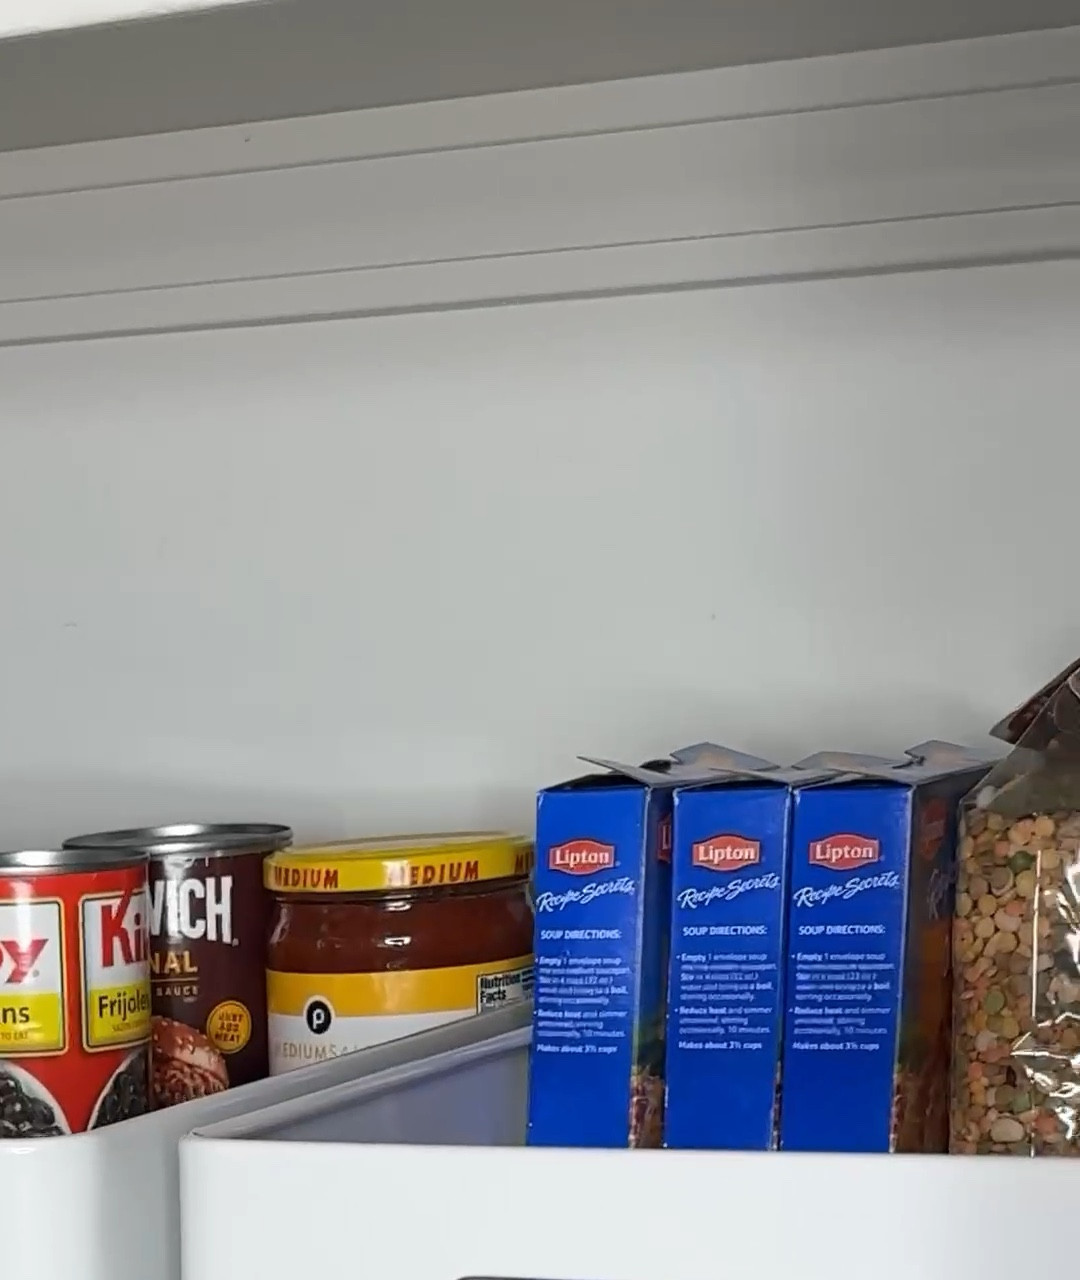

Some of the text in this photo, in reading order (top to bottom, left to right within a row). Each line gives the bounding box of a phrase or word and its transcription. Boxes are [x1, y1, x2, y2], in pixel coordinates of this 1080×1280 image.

[554, 849, 610, 868] Lipton
[697, 845, 756, 864] Lipton
[815, 844, 873, 862] Lipton
[273, 868, 339, 889] MEDIUM
[677, 872, 781, 909] Recipe Secrets
[793, 870, 900, 908] Recipe Secrets
[147, 875, 234, 945] WICH
[682, 924, 768, 937] SOUP DIRECTIONS:
[798, 923, 886, 936] SOUP DIRECTIONS:
[282, 1042, 328, 1060] EDIUM
